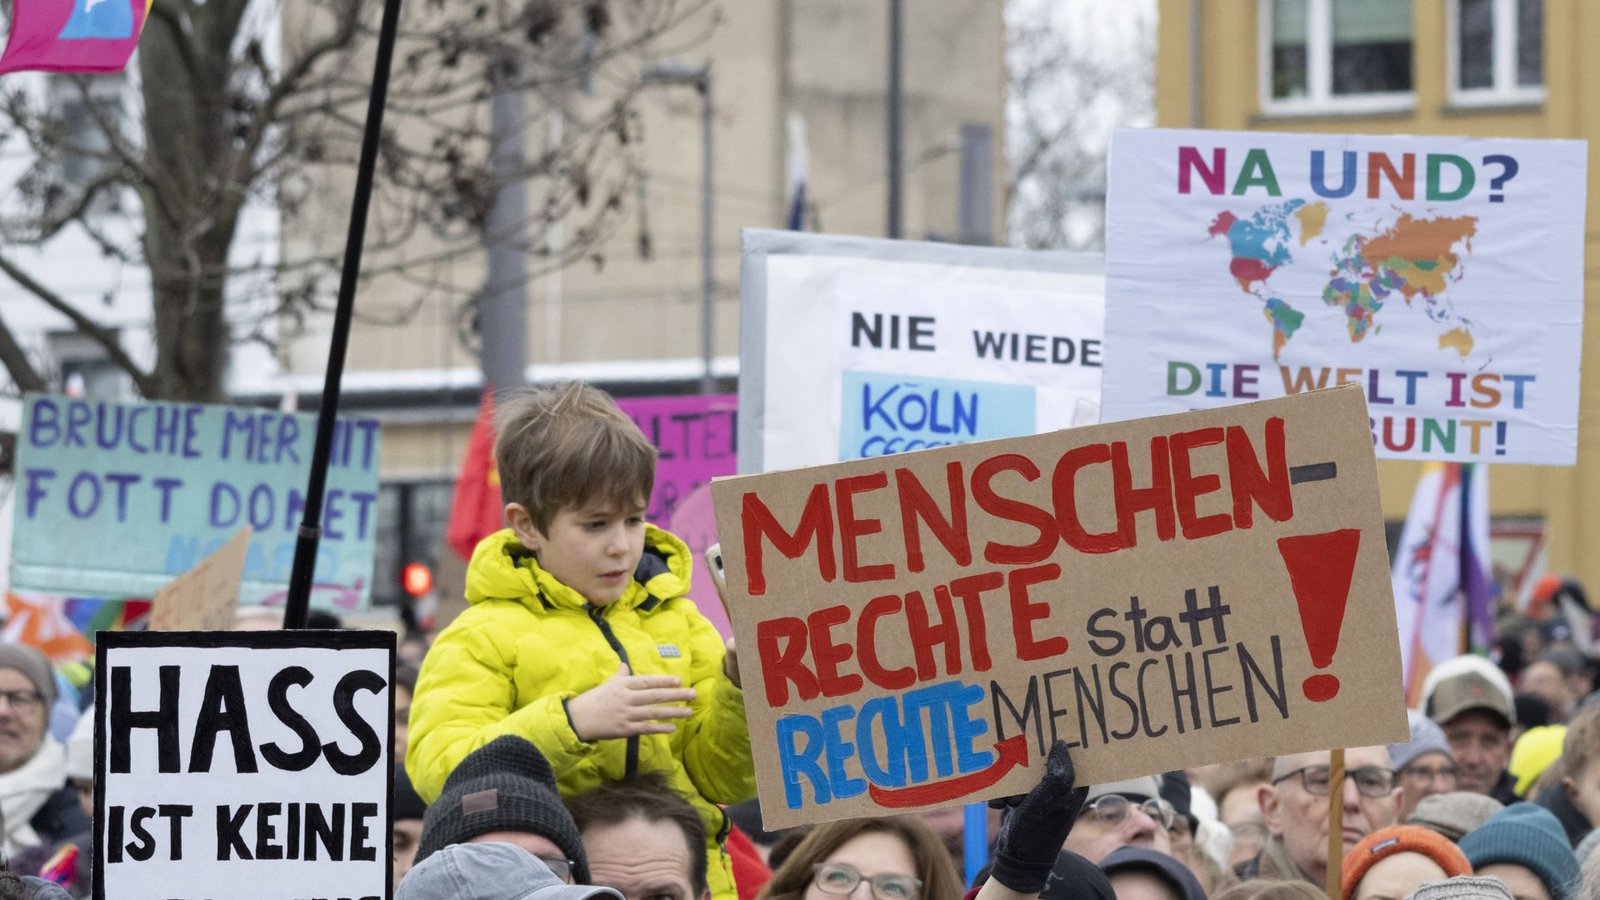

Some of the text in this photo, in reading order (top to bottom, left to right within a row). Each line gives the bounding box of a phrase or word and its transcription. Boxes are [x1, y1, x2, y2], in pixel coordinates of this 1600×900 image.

[1177, 146, 1519, 203] NA UND?
[851, 312, 936, 351] NIE
[1167, 361, 1260, 399] DIE
[1445, 372, 1536, 409] IST
[29, 399, 203, 458] BRUCHE
[219, 410, 301, 464] MER
[632, 411, 737, 459] LTE
[24, 468, 184, 524] FOTT
[742, 417, 1337, 595] MENSCHEN-
[757, 563, 1069, 708] RECHTE
[110, 664, 388, 776] HASS
[776, 635, 1289, 809] RECHTE MENSCHEN
[107, 802, 378, 864] IST KEINE
